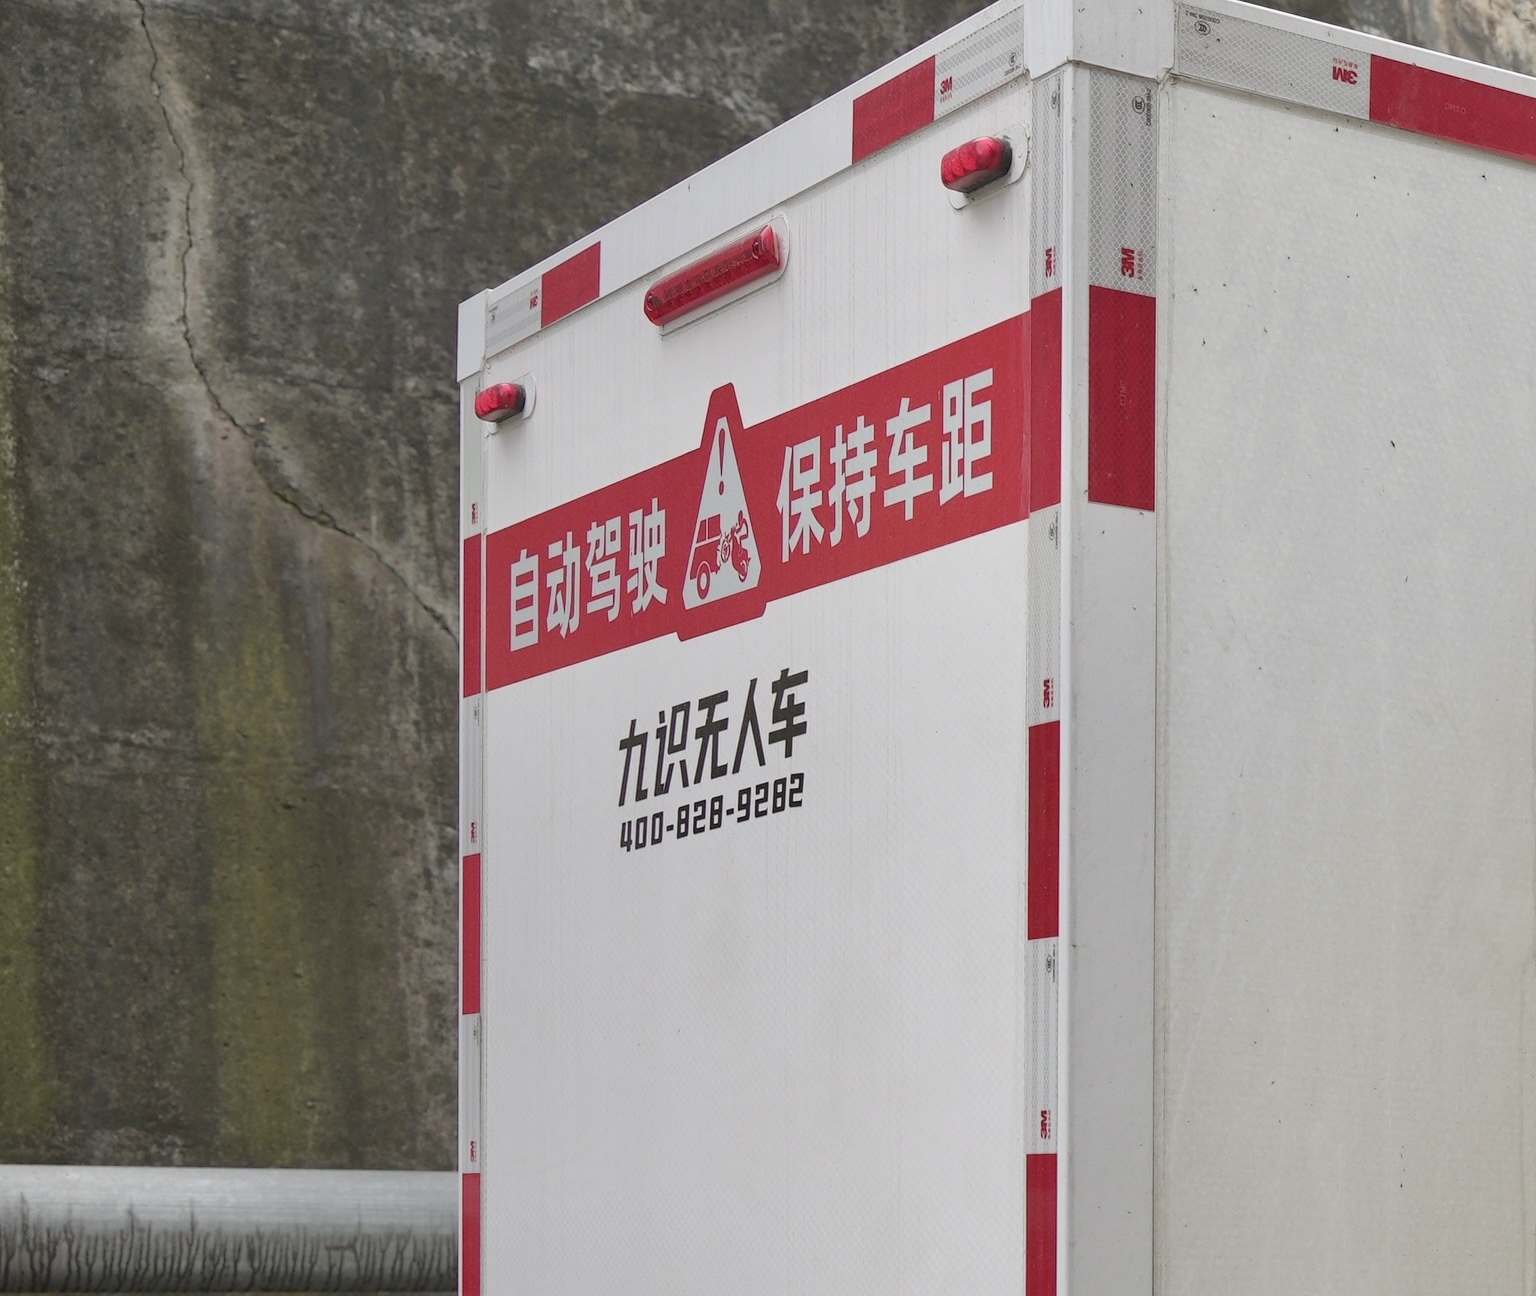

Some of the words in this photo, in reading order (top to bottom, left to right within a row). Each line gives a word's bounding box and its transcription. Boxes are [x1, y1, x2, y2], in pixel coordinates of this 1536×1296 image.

[940, 77, 953, 95] 3M
[1332, 64, 1358, 86] 3M
[1045, 247, 1053, 278] 3M
[1120, 247, 1135, 278] 3M
[776, 369, 995, 565] 保持车距
[509, 498, 668, 653] 自动驾驶
[1043, 678, 1051, 708] 3M
[618, 668, 809, 808] 九识无人车
[619, 773, 806, 853] 400-828-9282
[1040, 1109, 1048, 1139] 3M
